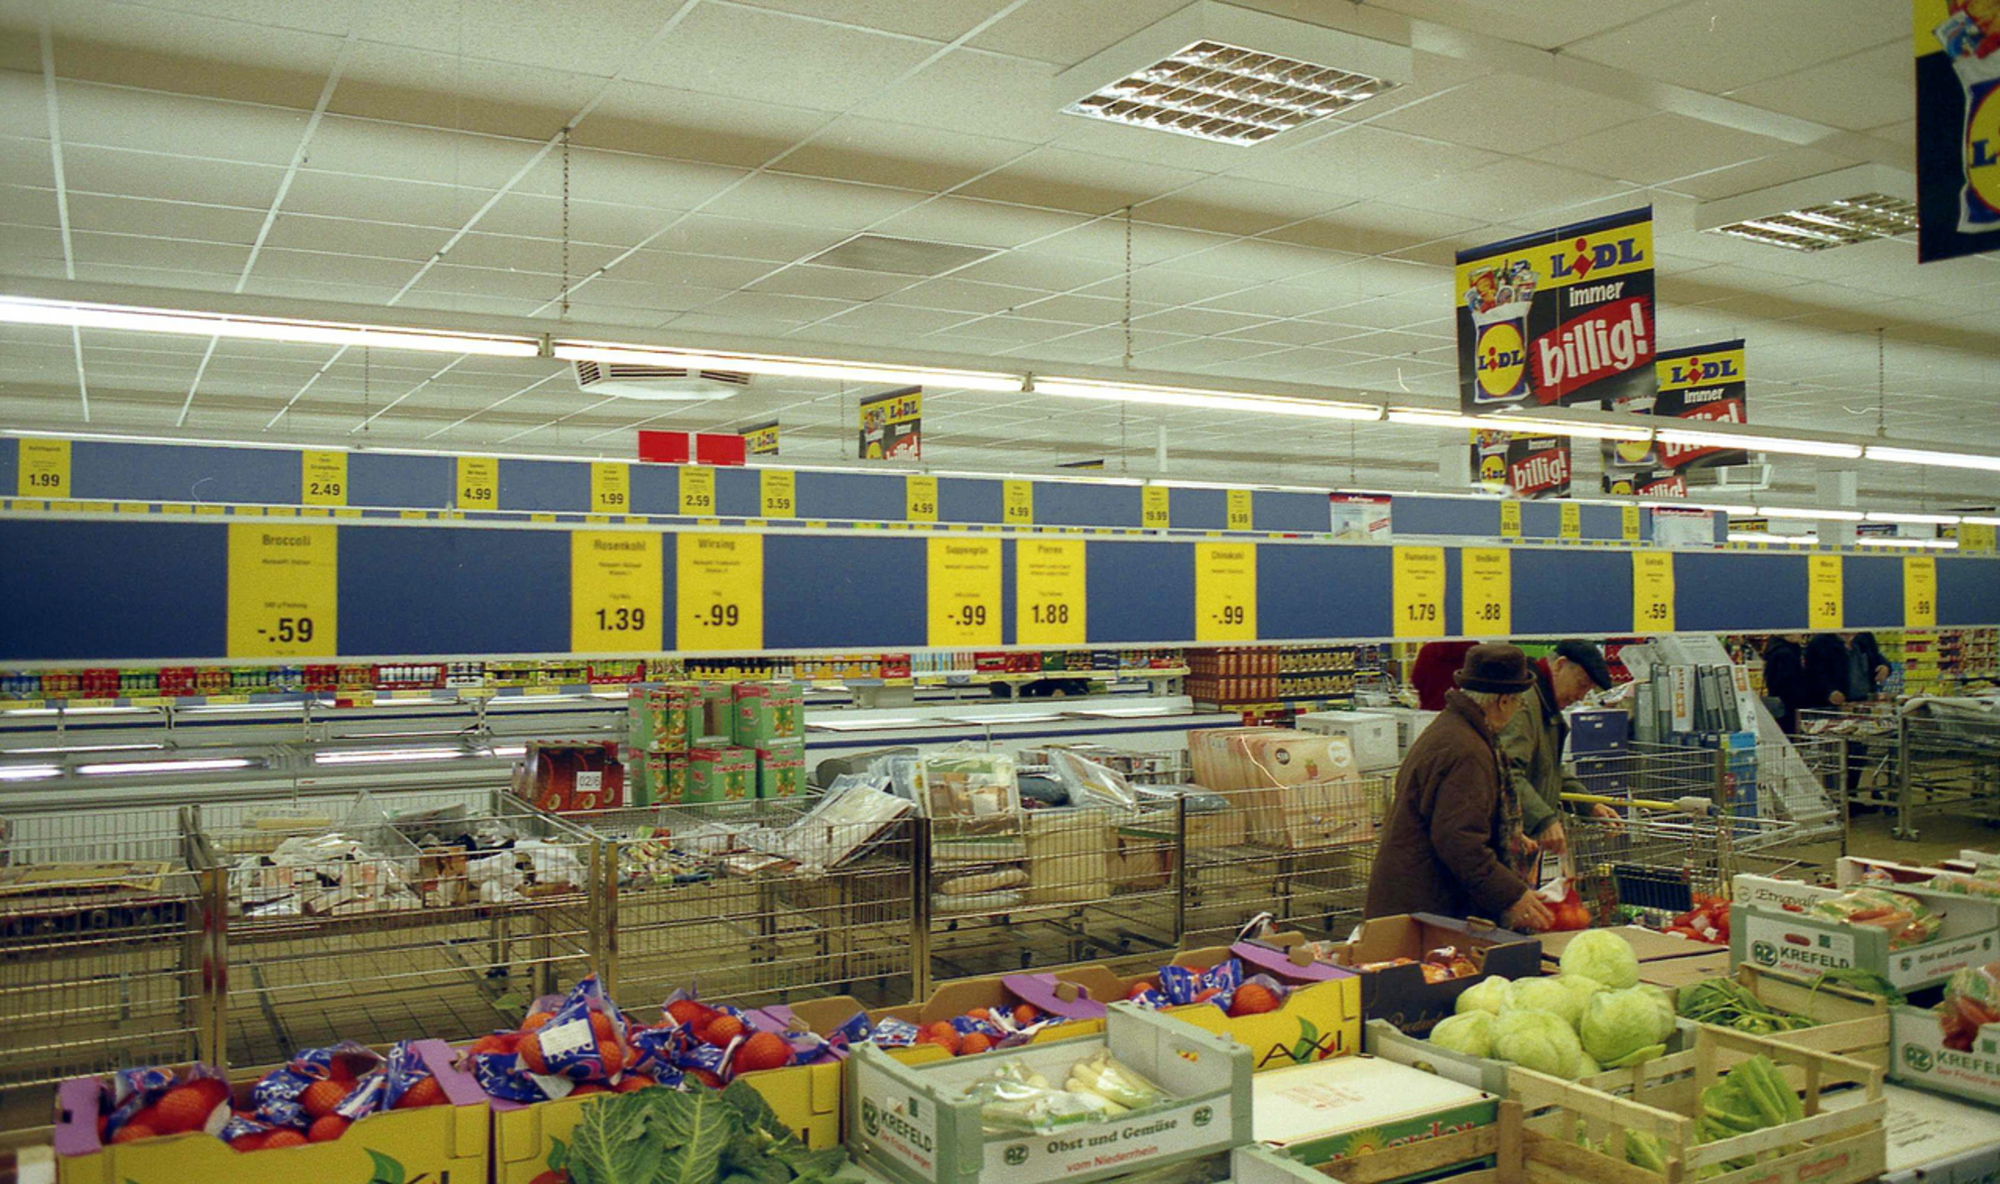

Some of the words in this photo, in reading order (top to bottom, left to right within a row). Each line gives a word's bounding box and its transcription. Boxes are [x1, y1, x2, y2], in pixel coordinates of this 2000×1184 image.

[1568, 280, 1625, 307] immer
[1538, 301, 1648, 387] billig!
[1684, 388, 1725, 404] immer
[29, 473, 60, 487] 1.99
[1512, 450, 1568, 491] billig!
[310, 482, 340, 496] 2.49
[463, 488, 491, 500] 4.99
[600, 493, 624, 505] 1.99
[686, 495, 710, 507] 2.59
[766, 498, 790, 509] 3.59
[912, 503, 934, 514] 4.99
[262, 534, 311, 546] Broccoli
[698, 539, 736, 551] Wirsing
[595, 608, 645, 631] 1.39
[694, 604, 739, 627] -.99
[947, 605, 987, 626] -.99
[1031, 604, 1069, 624] 1.88
[1212, 605, 1244, 625] -.99
[1407, 603, 1436, 621] 1.79
[1645, 603, 1667, 619] -.59
[257, 617, 313, 643] -.59
[1780, 946, 1849, 969] KREFELD
[880, 1108, 932, 1154] KREFELD
[1046, 1138, 1083, 1154] Obst
[1088, 1130, 1118, 1146] und
[1122, 1117, 1178, 1140] Gemüse
[1066, 1159, 1092, 1173] vom
[1094, 1145, 1159, 1167] Niederrhein
